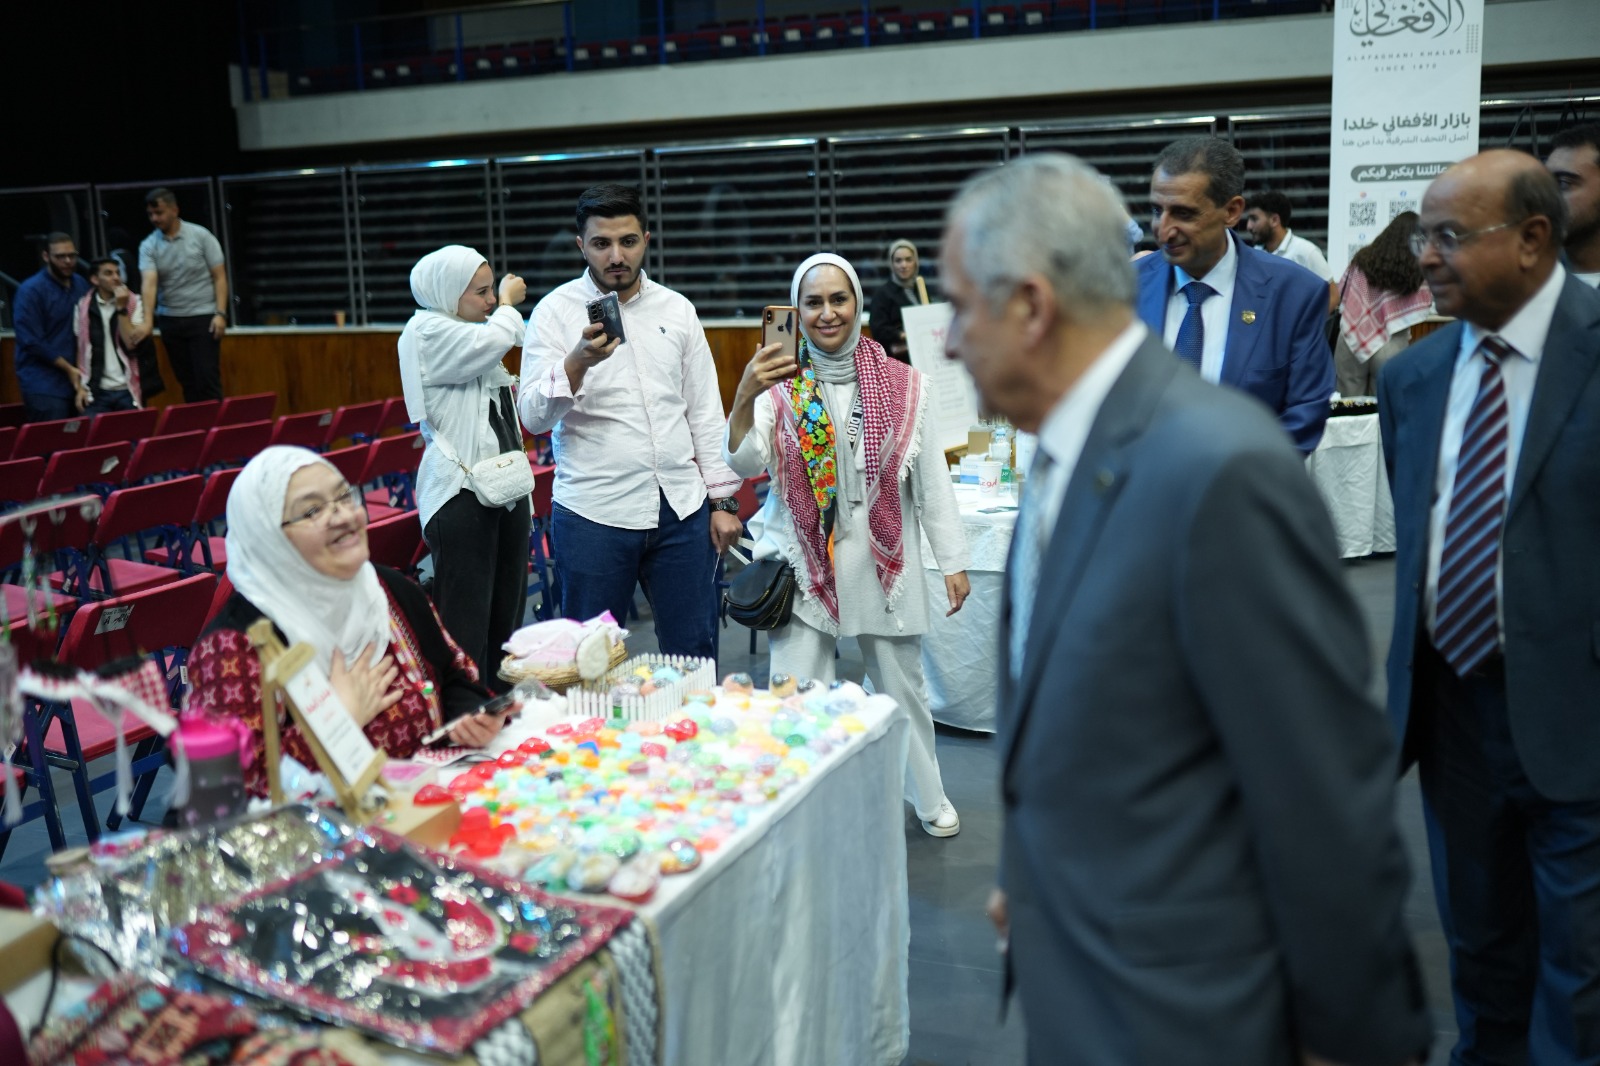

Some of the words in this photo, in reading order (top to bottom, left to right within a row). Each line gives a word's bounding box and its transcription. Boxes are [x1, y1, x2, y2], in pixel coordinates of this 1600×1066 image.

[1420, 49, 1461, 57] KHALDA
[1375, 64, 1405, 72] SINCE
[1343, 117, 1379, 131] خلدا
[1382, 112, 1437, 136] الأفغاني
[1440, 112, 1470, 129] بازار
[1357, 165, 1387, 182] فيكم
[1388, 165, 1414, 180] بتكبر
